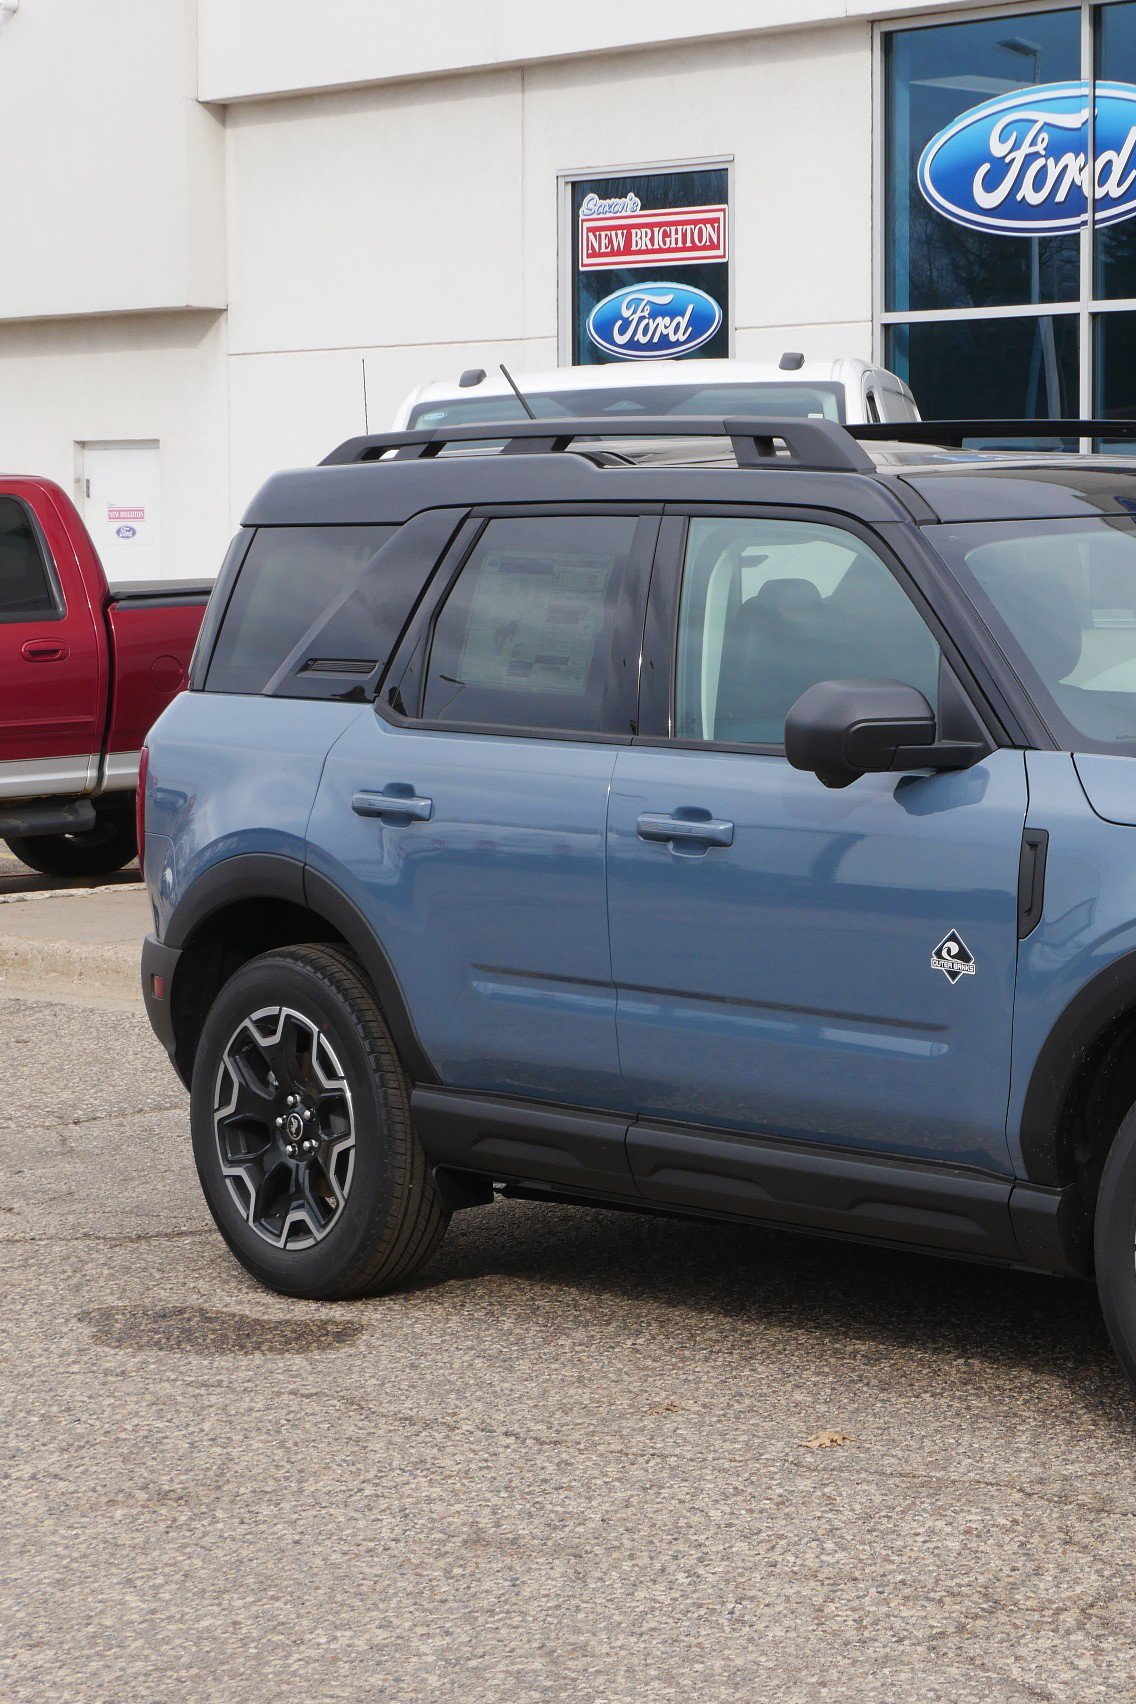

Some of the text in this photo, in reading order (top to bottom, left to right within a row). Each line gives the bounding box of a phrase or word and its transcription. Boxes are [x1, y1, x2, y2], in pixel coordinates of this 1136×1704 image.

[581, 194, 639, 216] Saxon's
[587, 222, 719, 254] NEW BRIGHTON
[612, 292, 695, 345] Ford
[932, 960, 974, 972] OUTER BANKS
